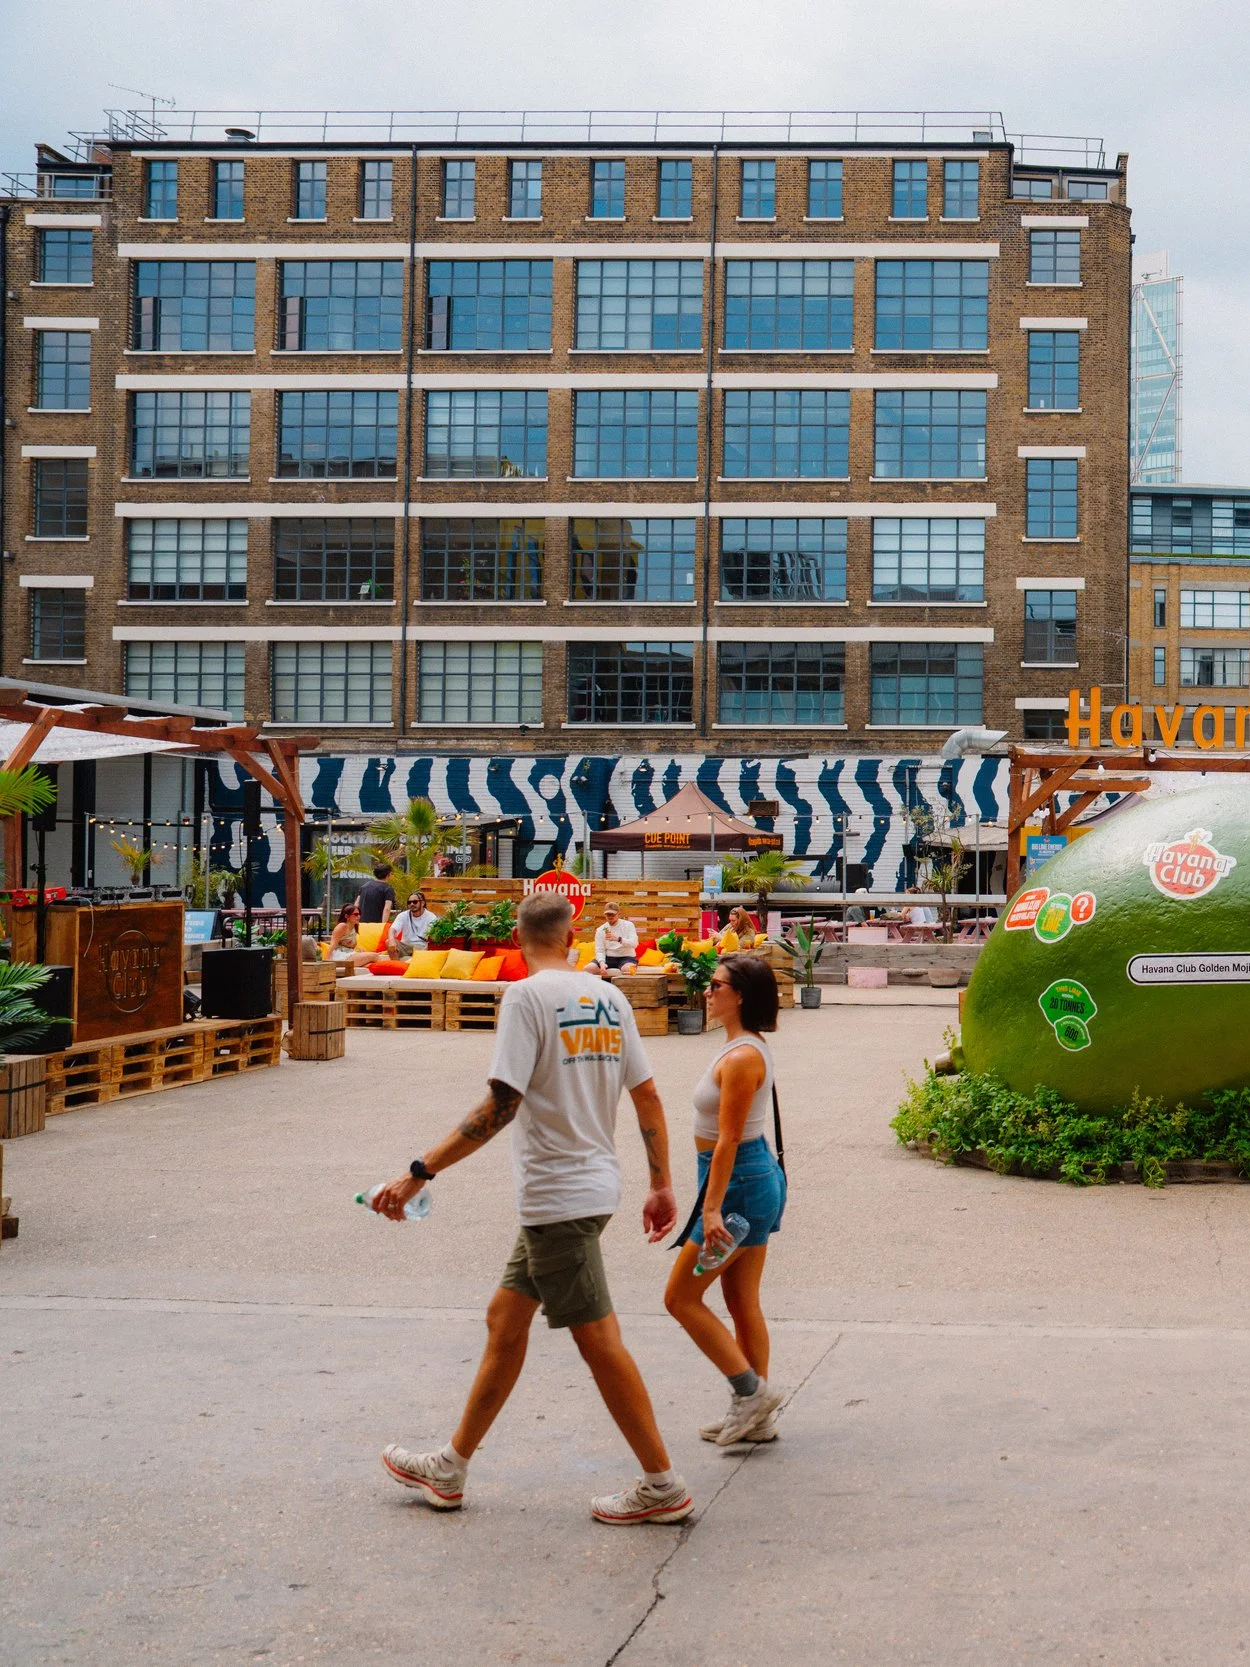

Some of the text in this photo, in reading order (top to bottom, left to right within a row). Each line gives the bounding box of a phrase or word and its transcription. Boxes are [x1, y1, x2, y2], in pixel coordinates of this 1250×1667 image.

[644, 832, 690, 844] CUE POINT
[1147, 846, 1228, 873] Havana
[1160, 865, 1206, 888] Club
[523, 879, 591, 896] Havana
[1141, 964, 1174, 974] Havana
[1176, 964, 1196, 973] Club
[1198, 963, 1230, 973] Golden
[112, 972, 147, 999] Club
[1049, 997, 1085, 1014] 20 TONNES
[560, 1027, 622, 1056] VANS
